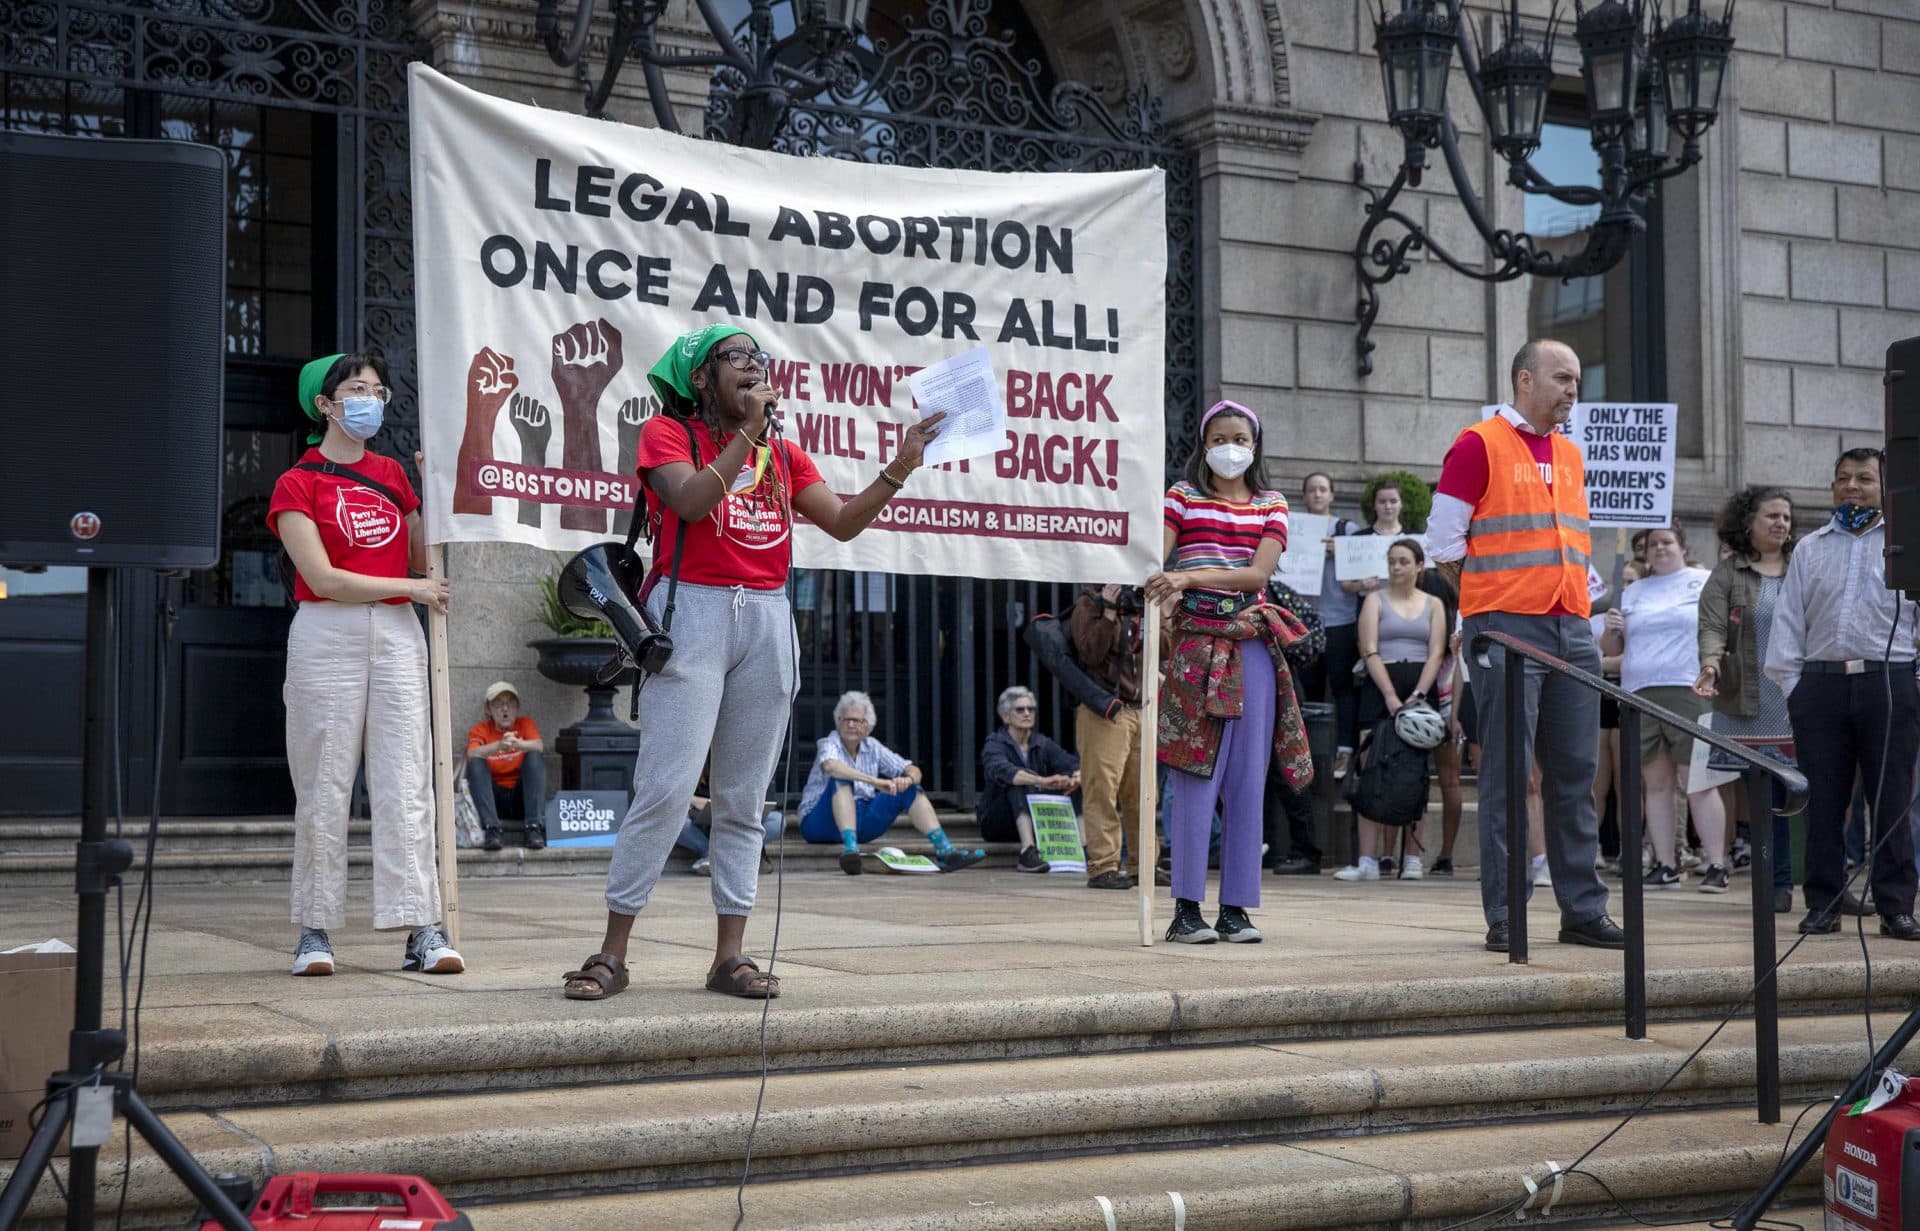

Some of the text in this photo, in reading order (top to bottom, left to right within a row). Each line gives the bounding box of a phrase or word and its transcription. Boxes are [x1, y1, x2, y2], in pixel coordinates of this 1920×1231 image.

[534, 158, 1074, 275] LEGAL ABORTION
[480, 234, 1121, 354] ONCE AND FOR ALL!
[768, 358, 811, 401] WE
[1006, 369, 1120, 423] BACK
[1589, 407, 1664, 425] ONLY THE
[1583, 426, 1668, 443] STRUGGLE
[796, 412, 866, 461] WILL
[994, 429, 1119, 491] BACK!
[1587, 445, 1662, 462] HAS WON
[1583, 470, 1666, 490] WOMEN'S
[1589, 491, 1654, 510] RIGHTS
[873, 504, 1123, 538] OCIALISM & LIBERATION
[354, 526, 390, 539] Liberation
[559, 799, 593, 810] BANS
[559, 809, 615, 821] OFF OUR
[560, 820, 610, 832] BODIES
[1843, 1141, 1878, 1167] HONDA
[1852, 1178, 1873, 1198] United
[1852, 1191, 1875, 1212] Rentals
